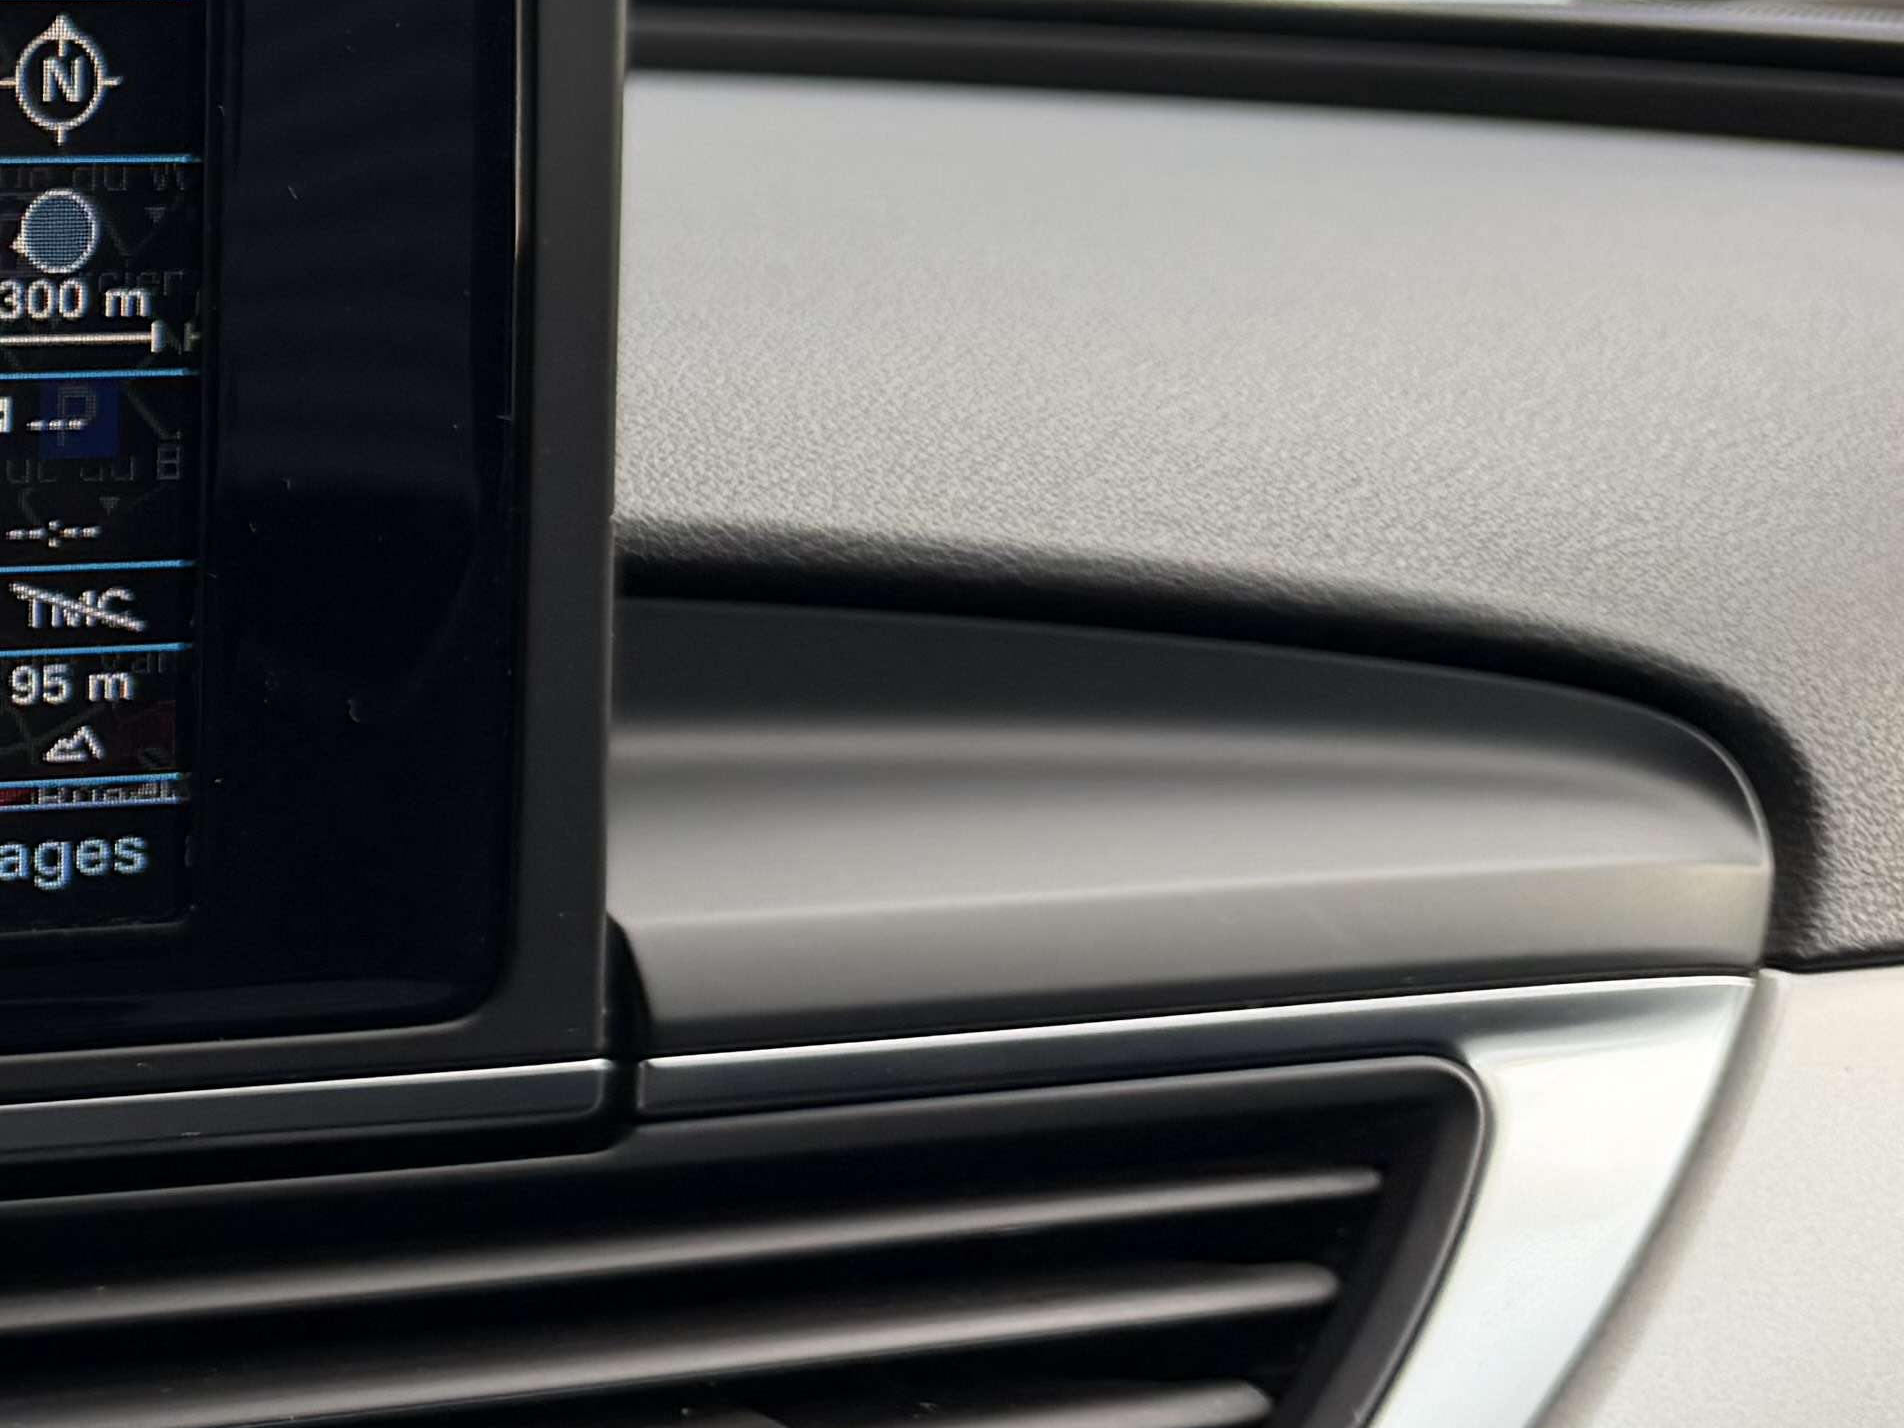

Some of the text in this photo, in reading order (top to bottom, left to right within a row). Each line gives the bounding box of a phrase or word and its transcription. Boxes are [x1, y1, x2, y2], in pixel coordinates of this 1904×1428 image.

[105, 288, 153, 317] m
[12, 666, 74, 706] 95
[89, 673, 134, 703] m
